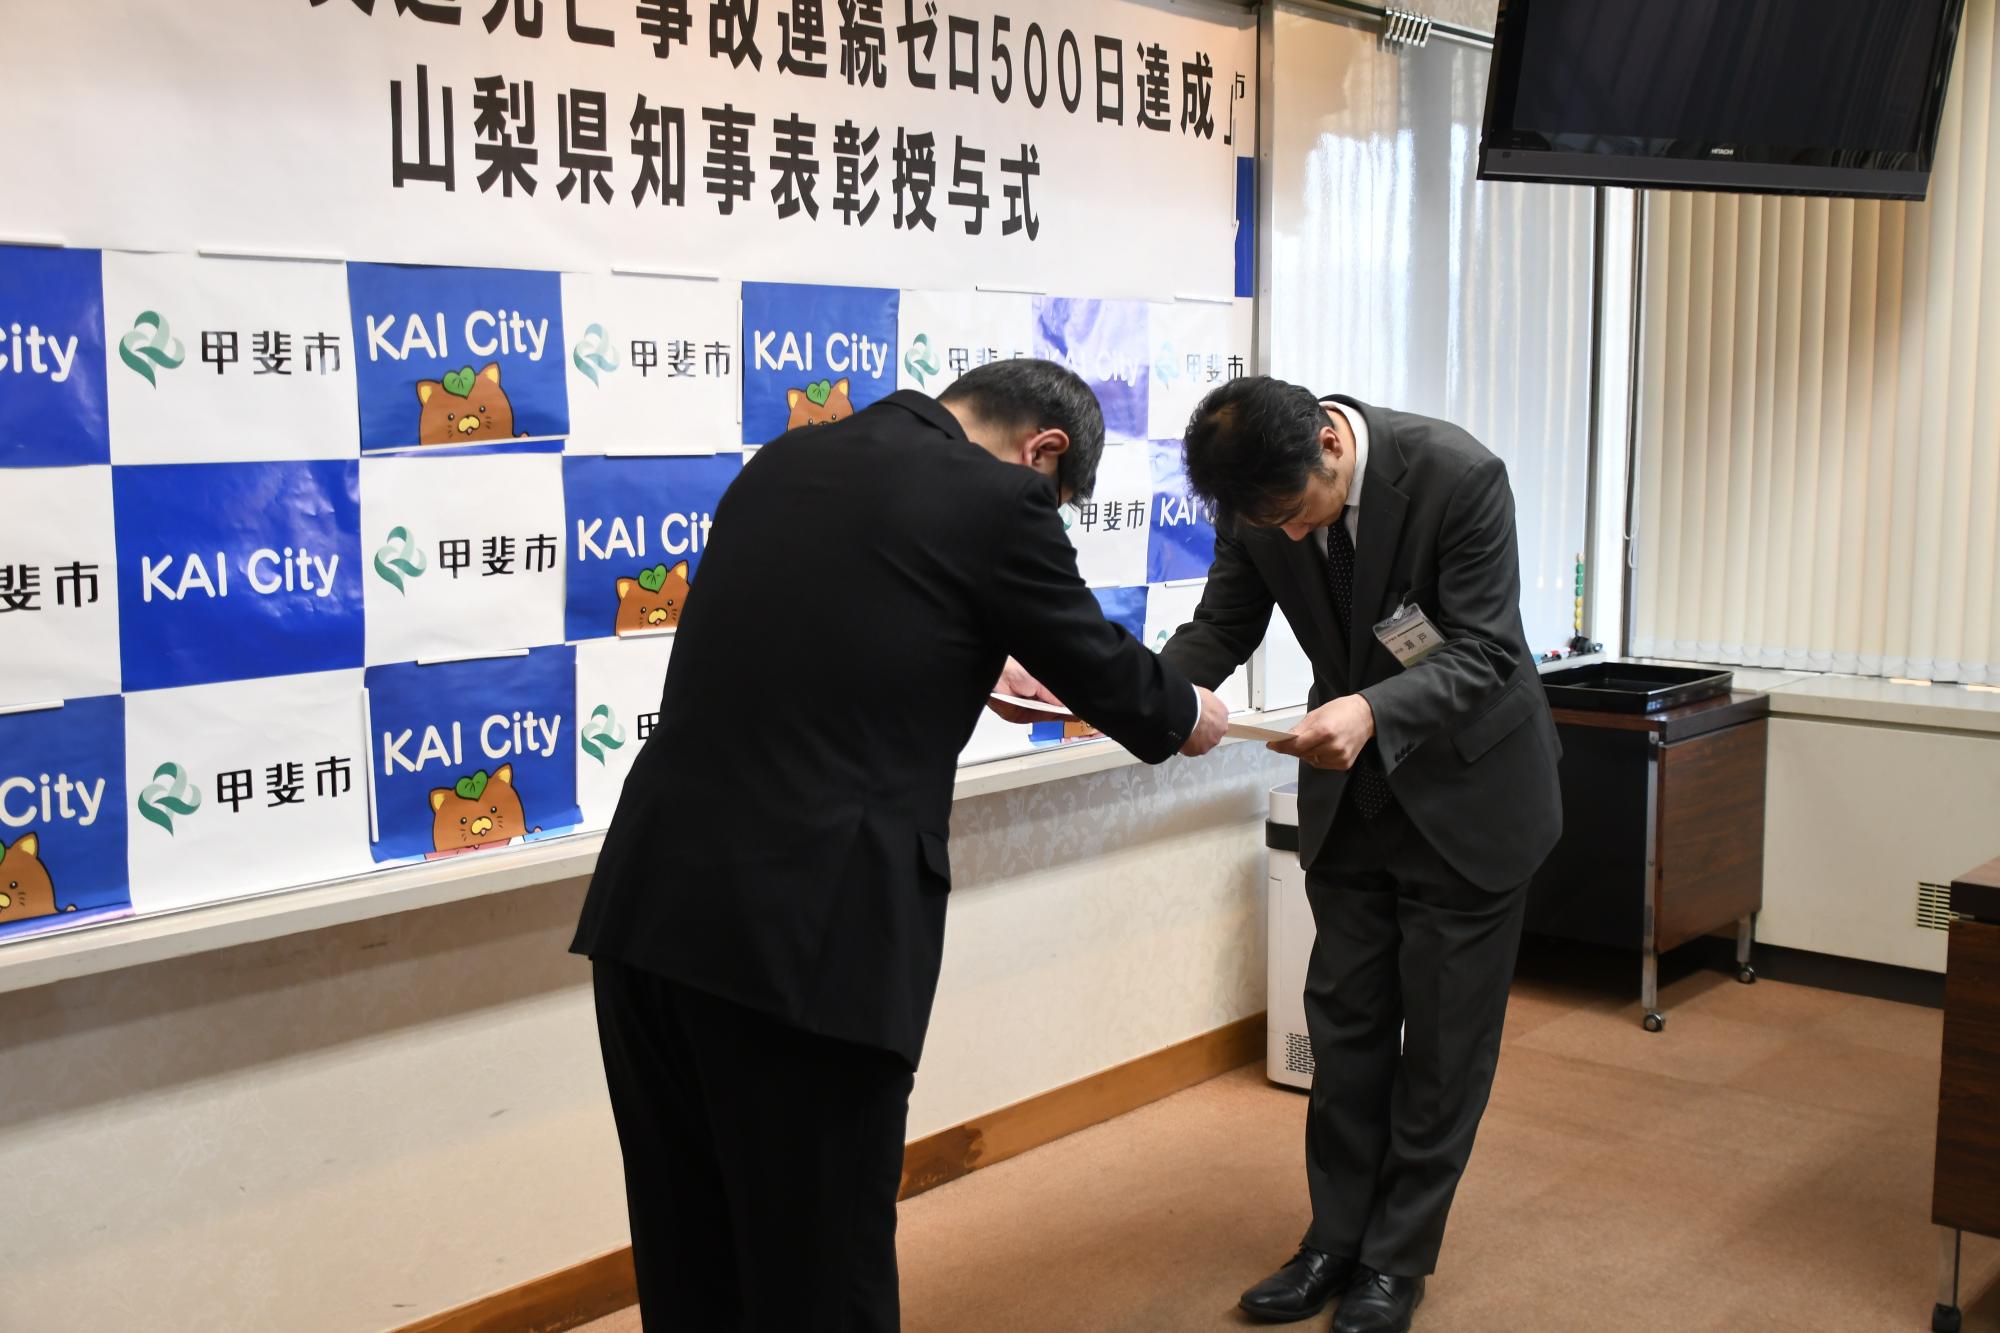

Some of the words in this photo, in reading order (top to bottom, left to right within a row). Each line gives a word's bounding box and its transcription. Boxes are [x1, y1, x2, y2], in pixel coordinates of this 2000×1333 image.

[308, 0, 1233, 146] 事故連続ゼロ500日達成」
[390, 63, 1041, 242] 山梨県知事表彰授与式
[0, 323, 78, 383] ity
[201, 330, 341, 376] 甲斐市
[366, 312, 449, 362] KAI
[464, 308, 549, 362] City
[630, 340, 731, 378] 甲斐市
[754, 330, 813, 371] KAI
[825, 331, 888, 379] City
[577, 515, 646, 562] KAI
[660, 511, 713, 555] Cit
[1080, 499, 1145, 533] 甲斐市
[1159, 496, 1197, 528] KAI
[141, 551, 229, 603] KAI
[247, 546, 339, 598] City
[439, 533, 557, 580] 甲斐市
[383, 721, 463, 776] KAI
[480, 711, 561, 758] City
[0, 773, 106, 828] City
[216, 755, 351, 814] 甲斐市
